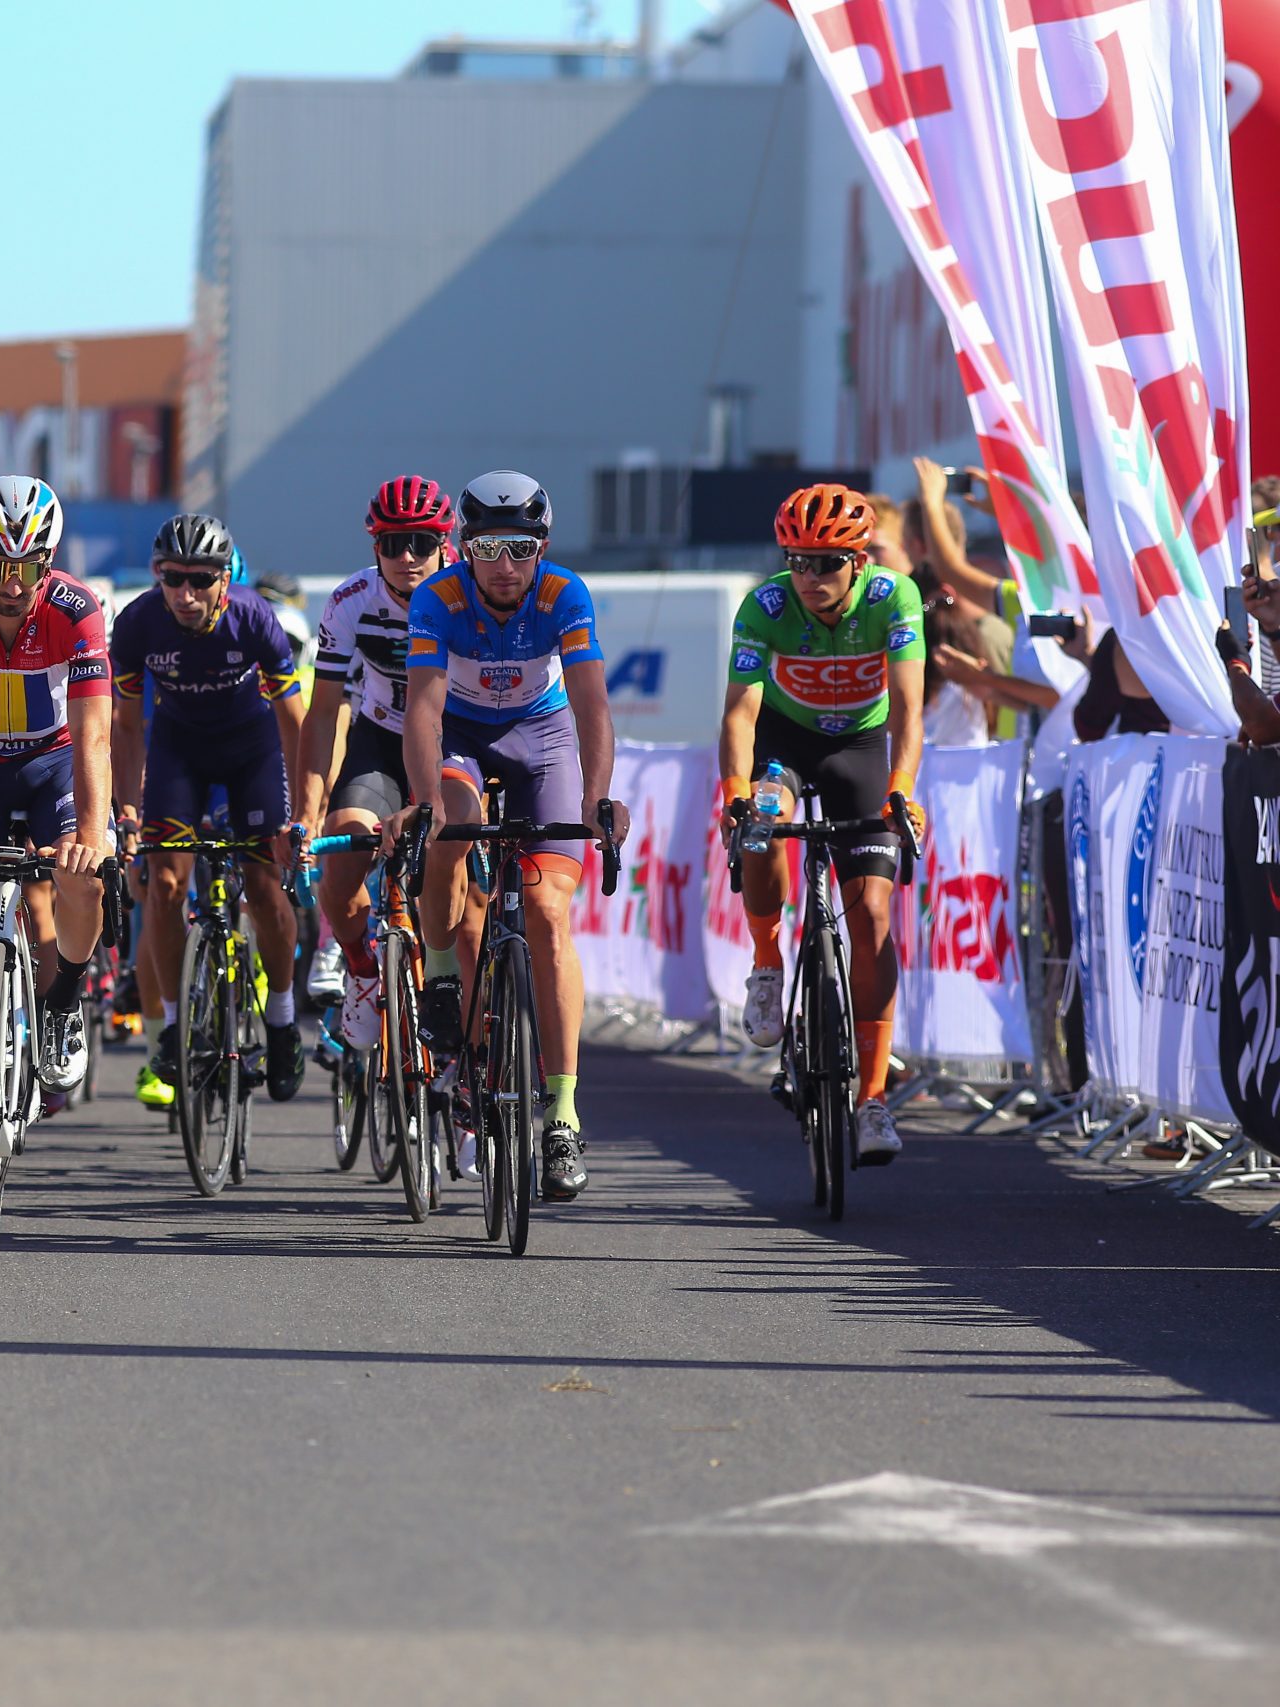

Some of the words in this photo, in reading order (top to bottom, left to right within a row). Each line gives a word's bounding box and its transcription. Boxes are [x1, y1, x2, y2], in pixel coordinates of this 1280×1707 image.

[52, 580, 87, 611] Dare
[762, 590, 783, 615] fit
[562, 643, 587, 654] orange
[70, 663, 102, 679] Dare
[736, 654, 757, 668] fit
[786, 659, 885, 685] CCC
[850, 845, 897, 858] sprandi
[0, 895, 7, 931] LOOK
